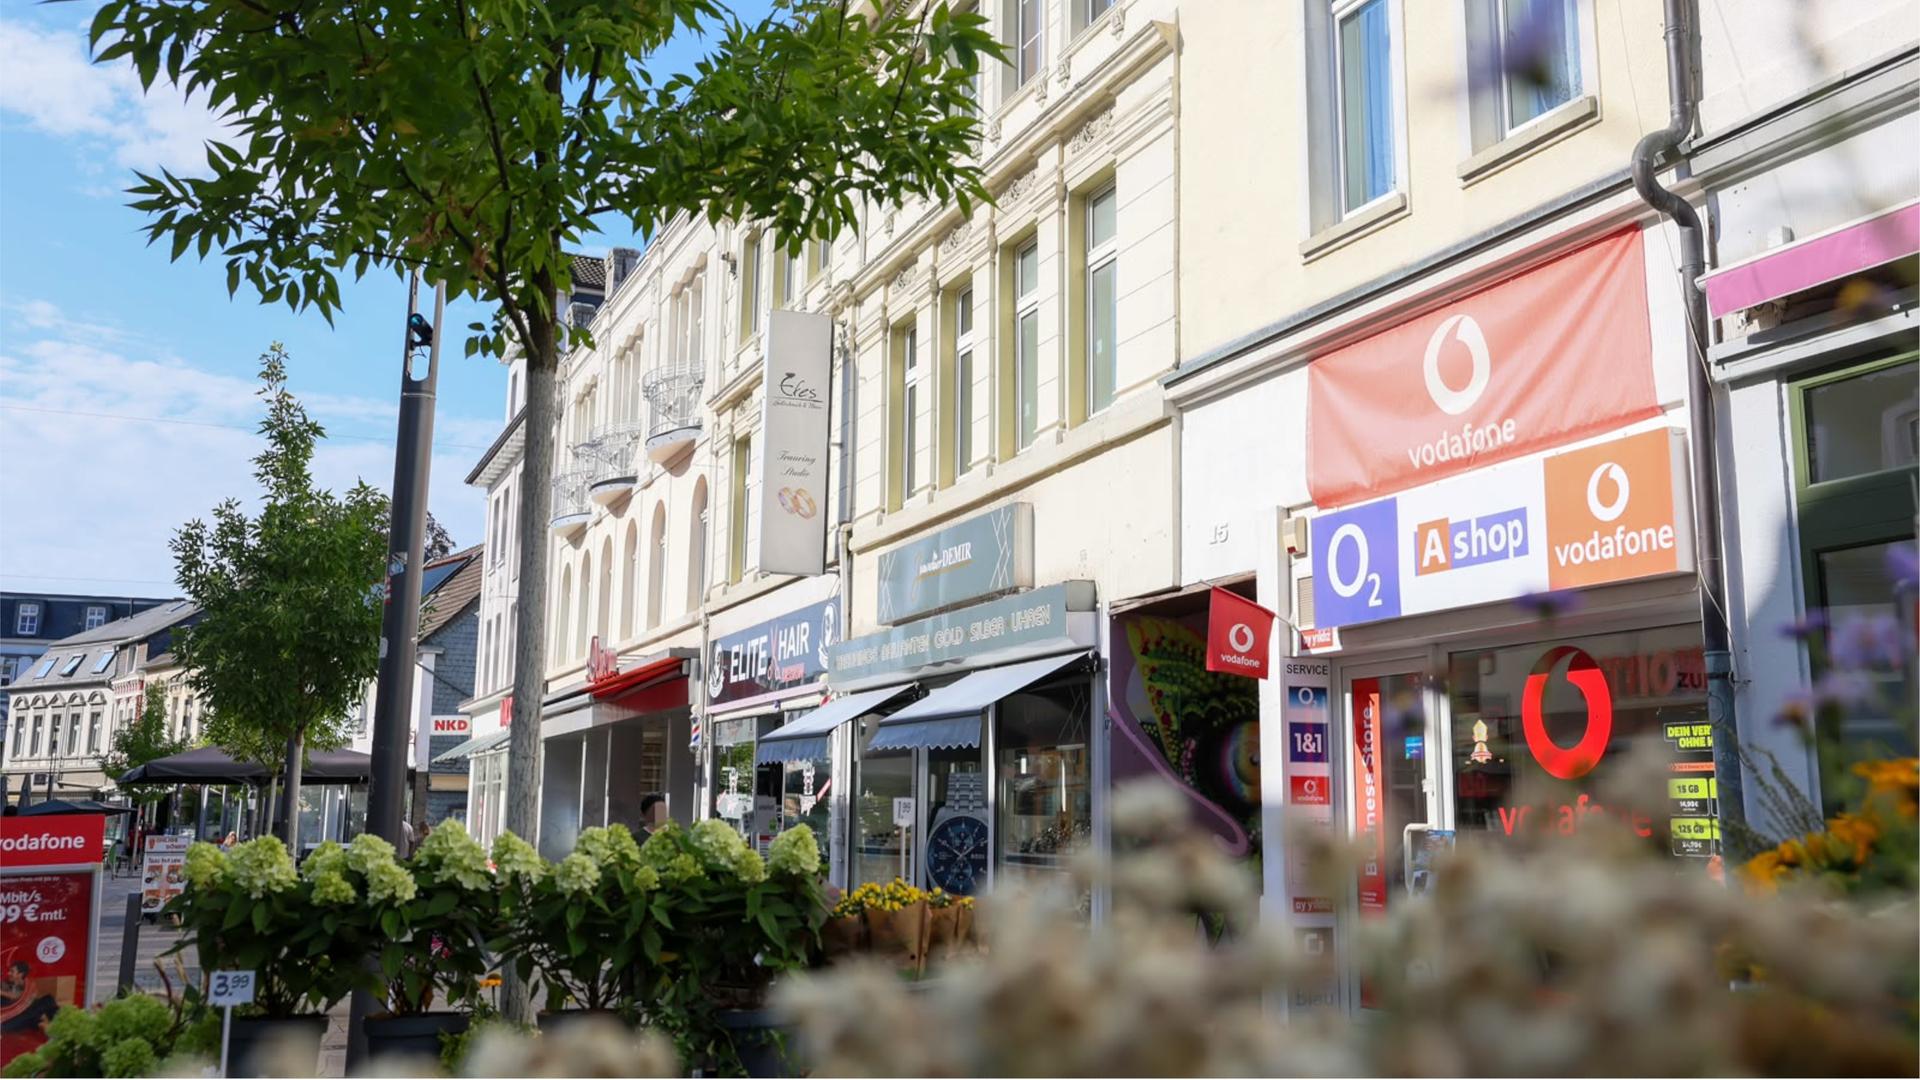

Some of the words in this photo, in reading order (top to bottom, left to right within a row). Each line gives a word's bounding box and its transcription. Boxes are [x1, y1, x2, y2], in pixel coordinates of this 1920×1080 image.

[1408, 416, 1517, 470] vodafone
[777, 449, 817, 465] Trauring
[1209, 521, 1229, 545] 15
[1453, 517, 1524, 560] shop
[942, 542, 972, 567] DEMIR
[1554, 524, 1674, 567] vodafone
[934, 626, 963, 649] GOLD
[970, 616, 1004, 642] SILBER
[1011, 604, 1051, 632] UHREN
[730, 634, 768, 684] ELITE
[778, 621, 810, 661] HAIR
[1220, 653, 1260, 668] vodafone
[1286, 663, 1329, 675] SERVICE
[434, 719, 469, 731] NKD
[1667, 726, 1690, 737] DEIN
[1294, 733, 1322, 753] 1&1
[1679, 737, 1706, 748] OHNE
[1688, 784, 1699, 793] GB
[0, 833, 85, 851] odafone
[0, 889, 42, 904] Mbit/s
[213, 973, 250, 998] 3.99
